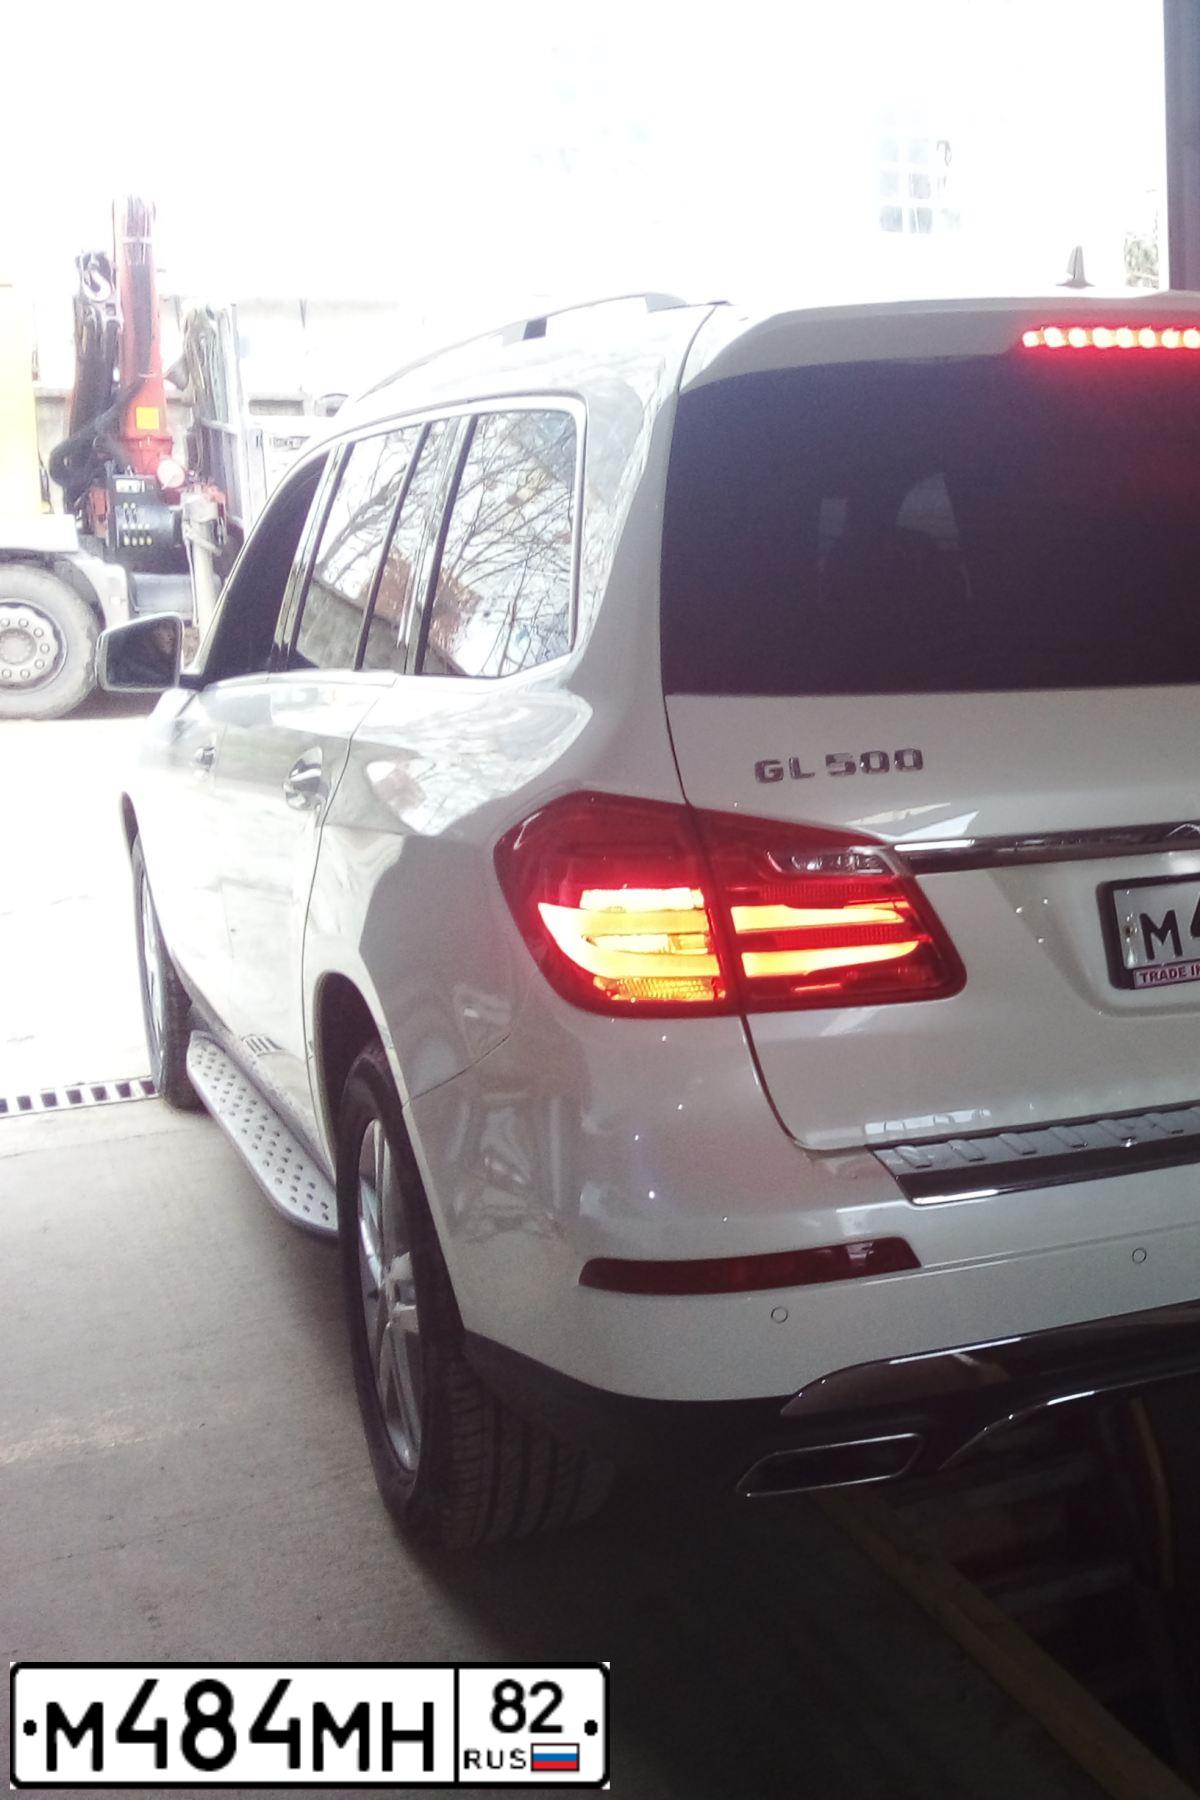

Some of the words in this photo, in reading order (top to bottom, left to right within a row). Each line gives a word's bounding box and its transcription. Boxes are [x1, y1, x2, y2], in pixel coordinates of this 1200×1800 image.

[754, 756, 815, 784] GL
[825, 748, 924, 777] 500
[1138, 966, 1188, 984] TRADE
